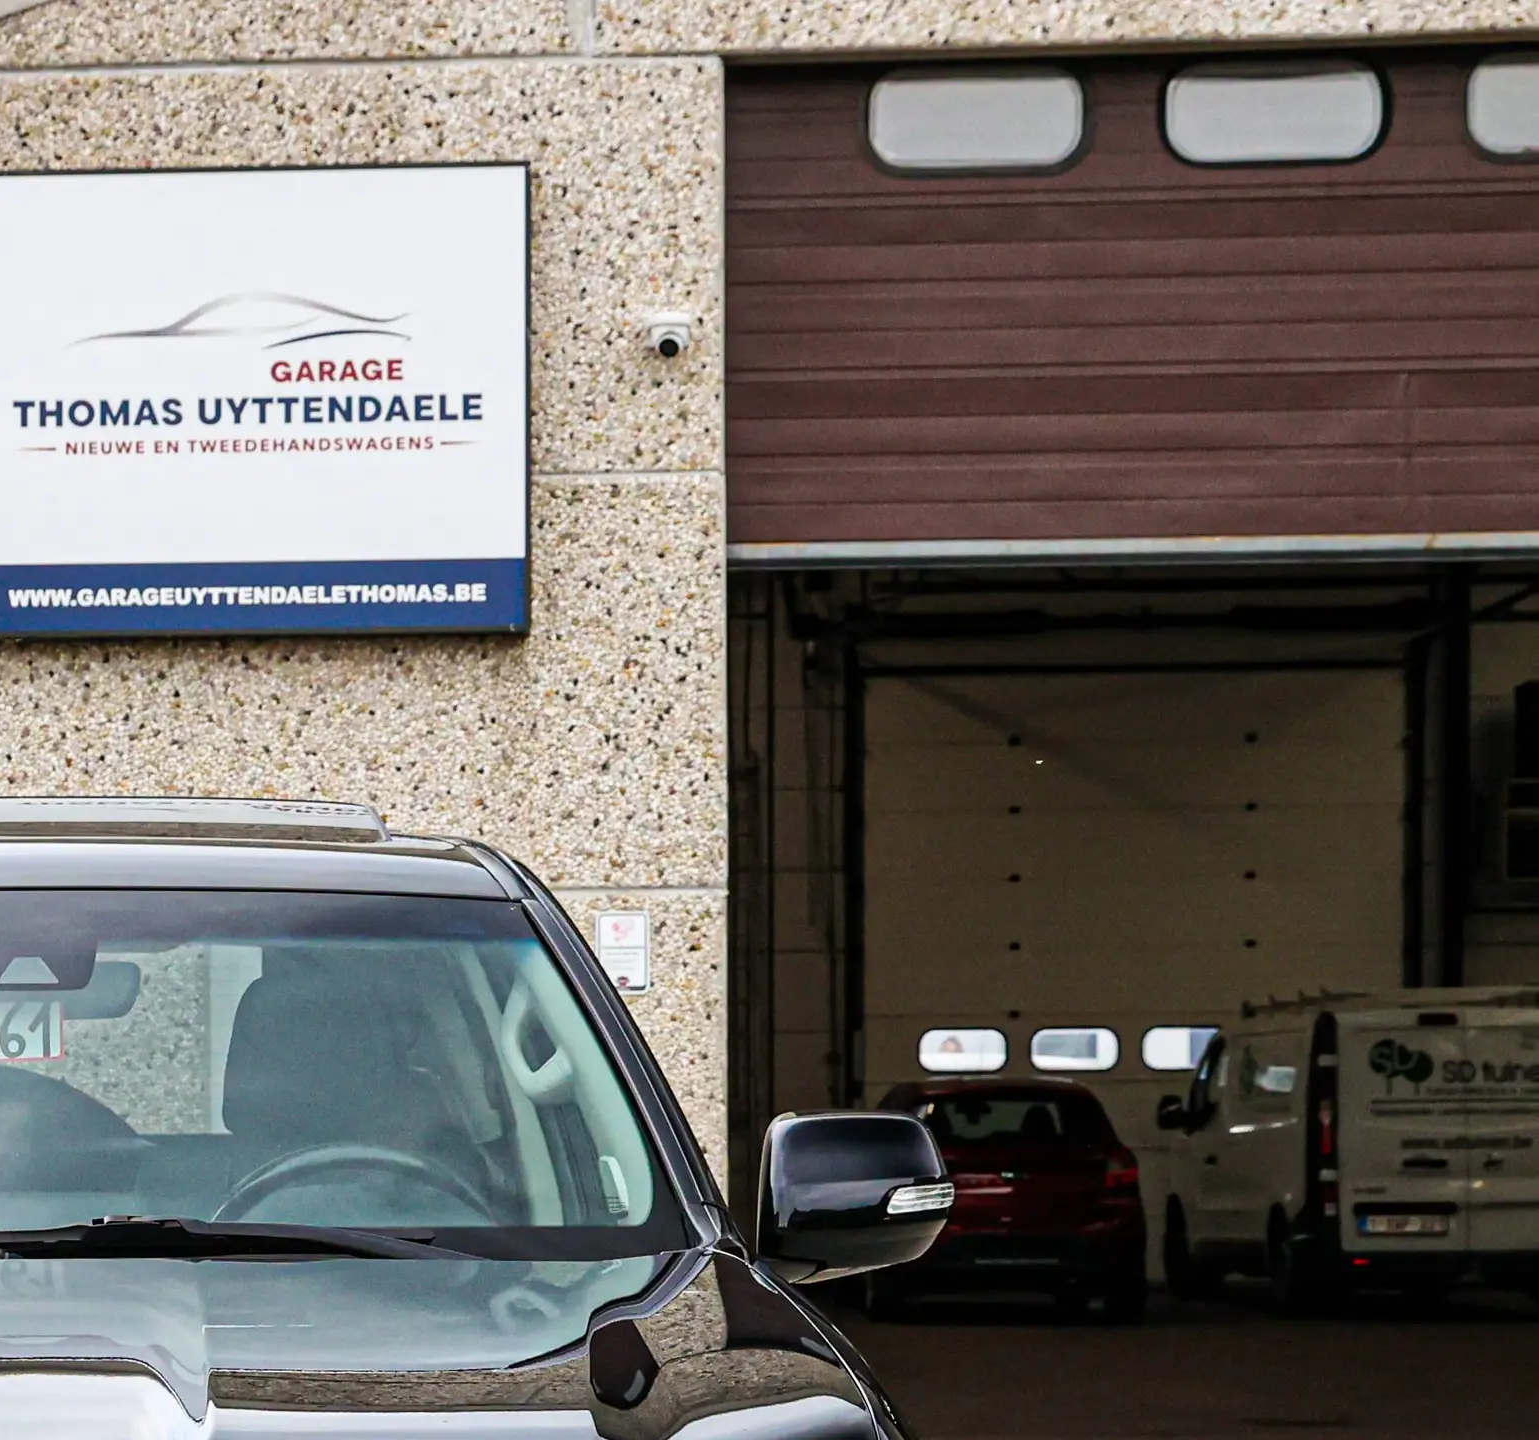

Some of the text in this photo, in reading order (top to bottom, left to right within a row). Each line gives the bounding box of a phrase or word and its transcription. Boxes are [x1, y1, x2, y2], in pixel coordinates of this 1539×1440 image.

[269, 358, 404, 384] GARAGE
[12, 393, 483, 428] THOMAS UYTTENDAELE
[64, 436, 435, 456] NIEUWE EN TWEEDEHANDSWAGENS
[8, 583, 487, 608] WWW.GARAGEUYTTENDAELETHOMAS.BE
